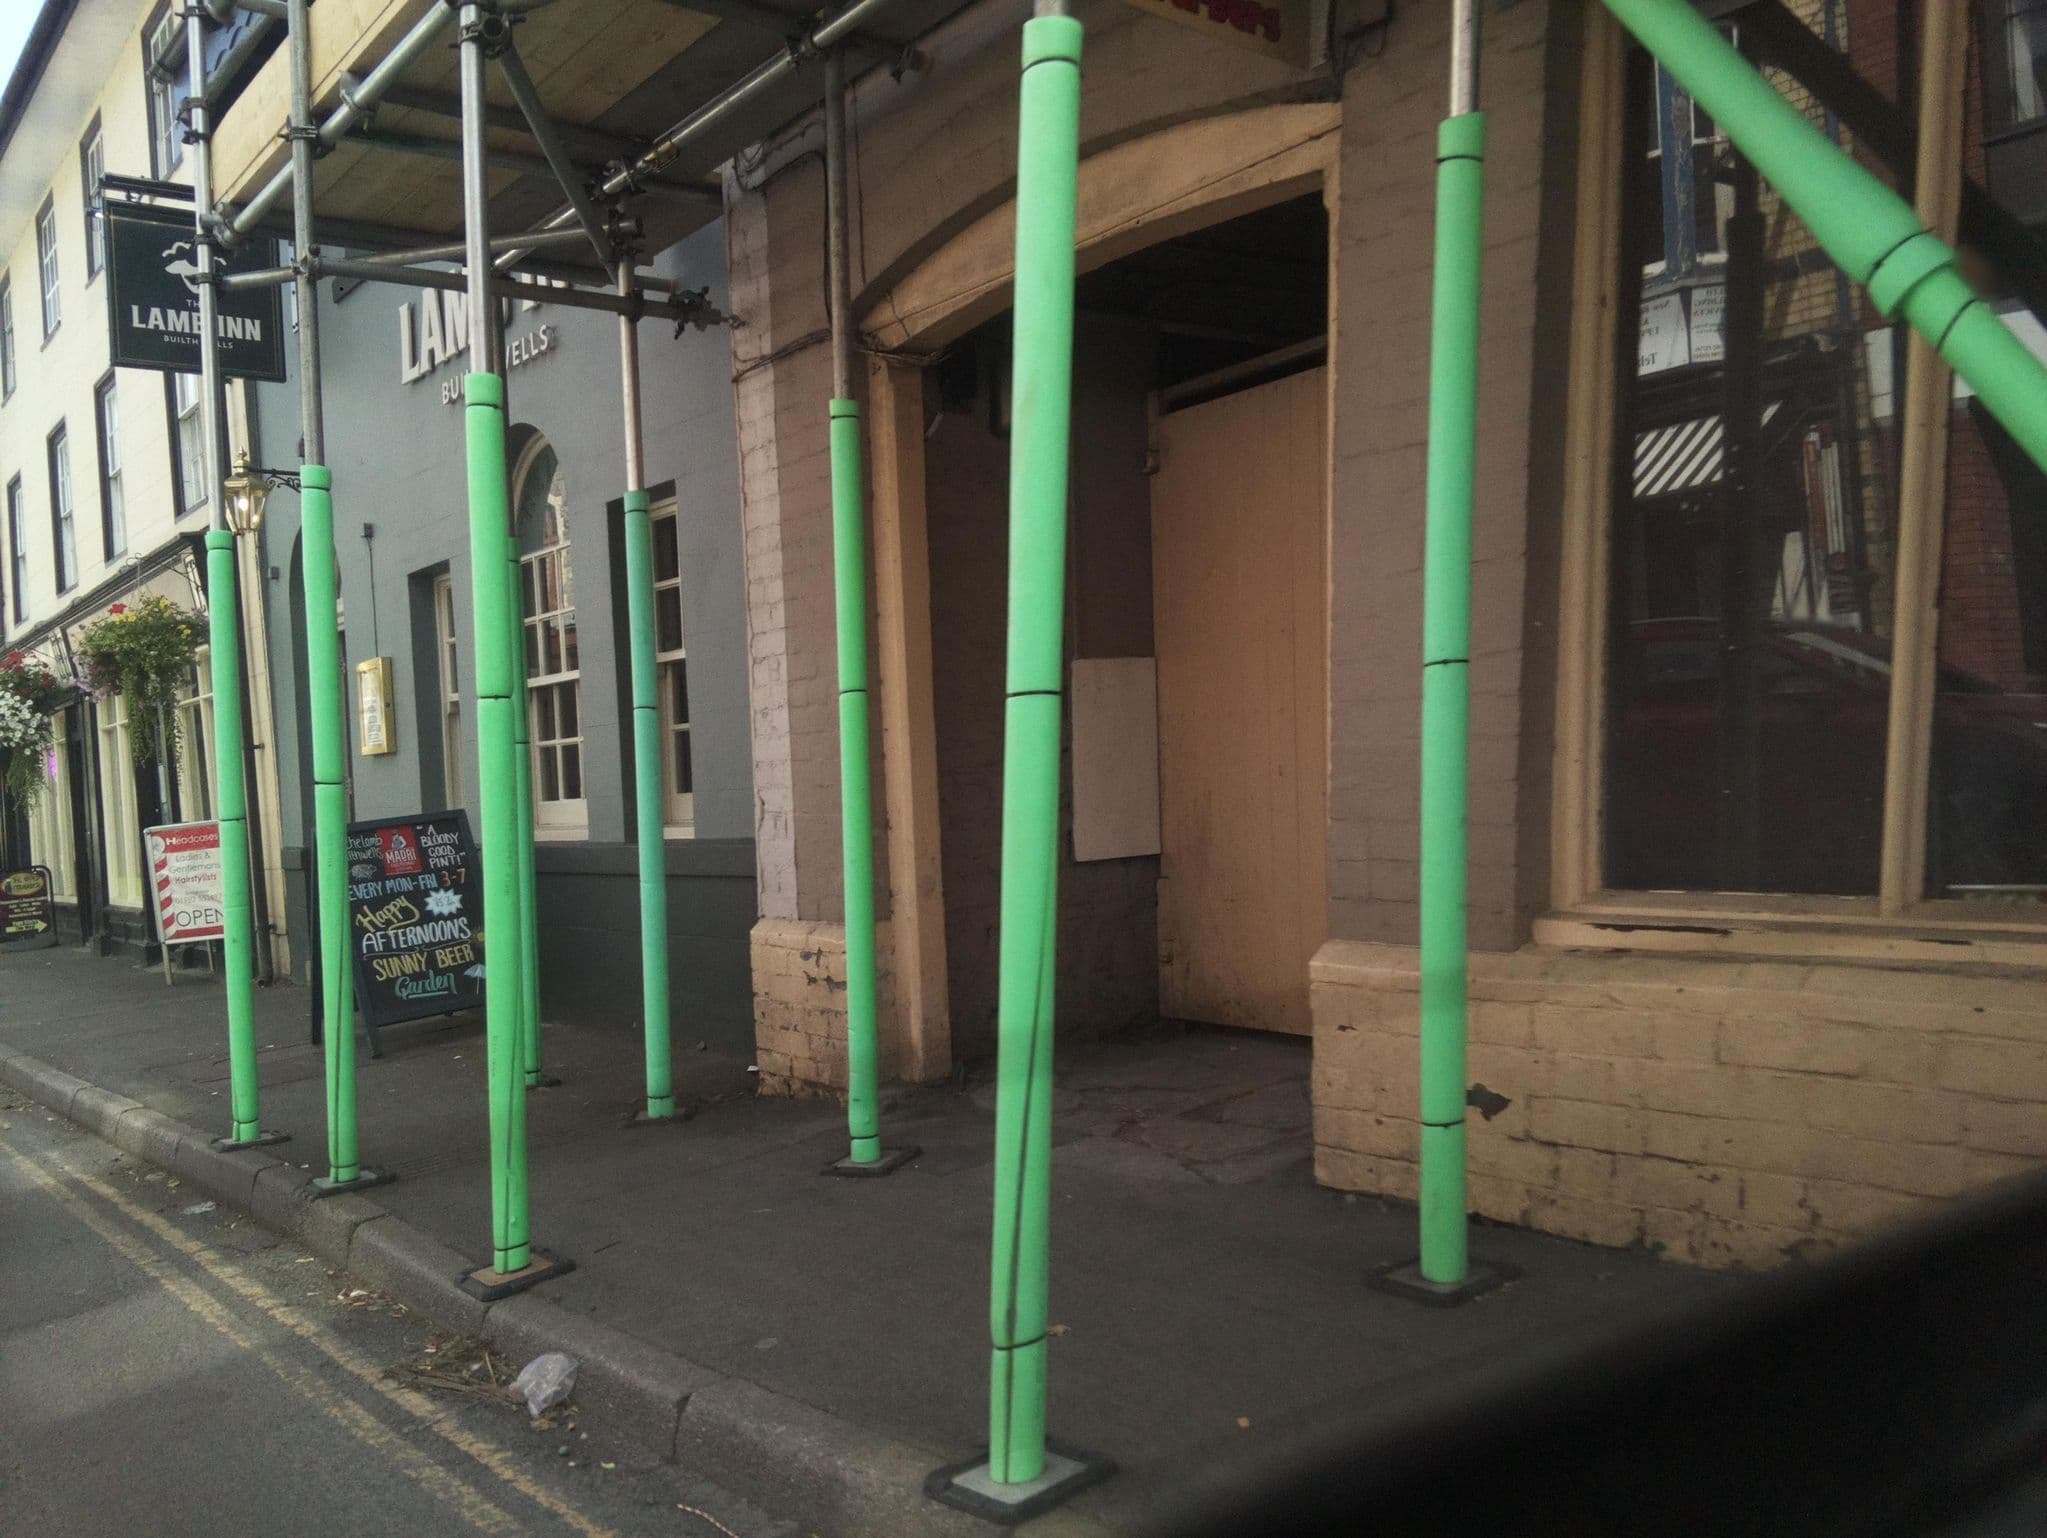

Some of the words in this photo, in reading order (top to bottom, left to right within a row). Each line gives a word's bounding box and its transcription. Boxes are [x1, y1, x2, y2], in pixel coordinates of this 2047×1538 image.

[186, 299, 200, 308] TH
[163, 335, 199, 345] BUILTH
[218, 315, 262, 342] INN
[420, 832, 459, 848] BLOODY
[428, 845, 456, 857] GOOD
[356, 895, 421, 933] Happy
[362, 917, 472, 954] AFTERNOONS
[372, 951, 428, 981] SUNNY
[435, 943, 475, 969] BEER
[395, 969, 457, 1000] Garden
